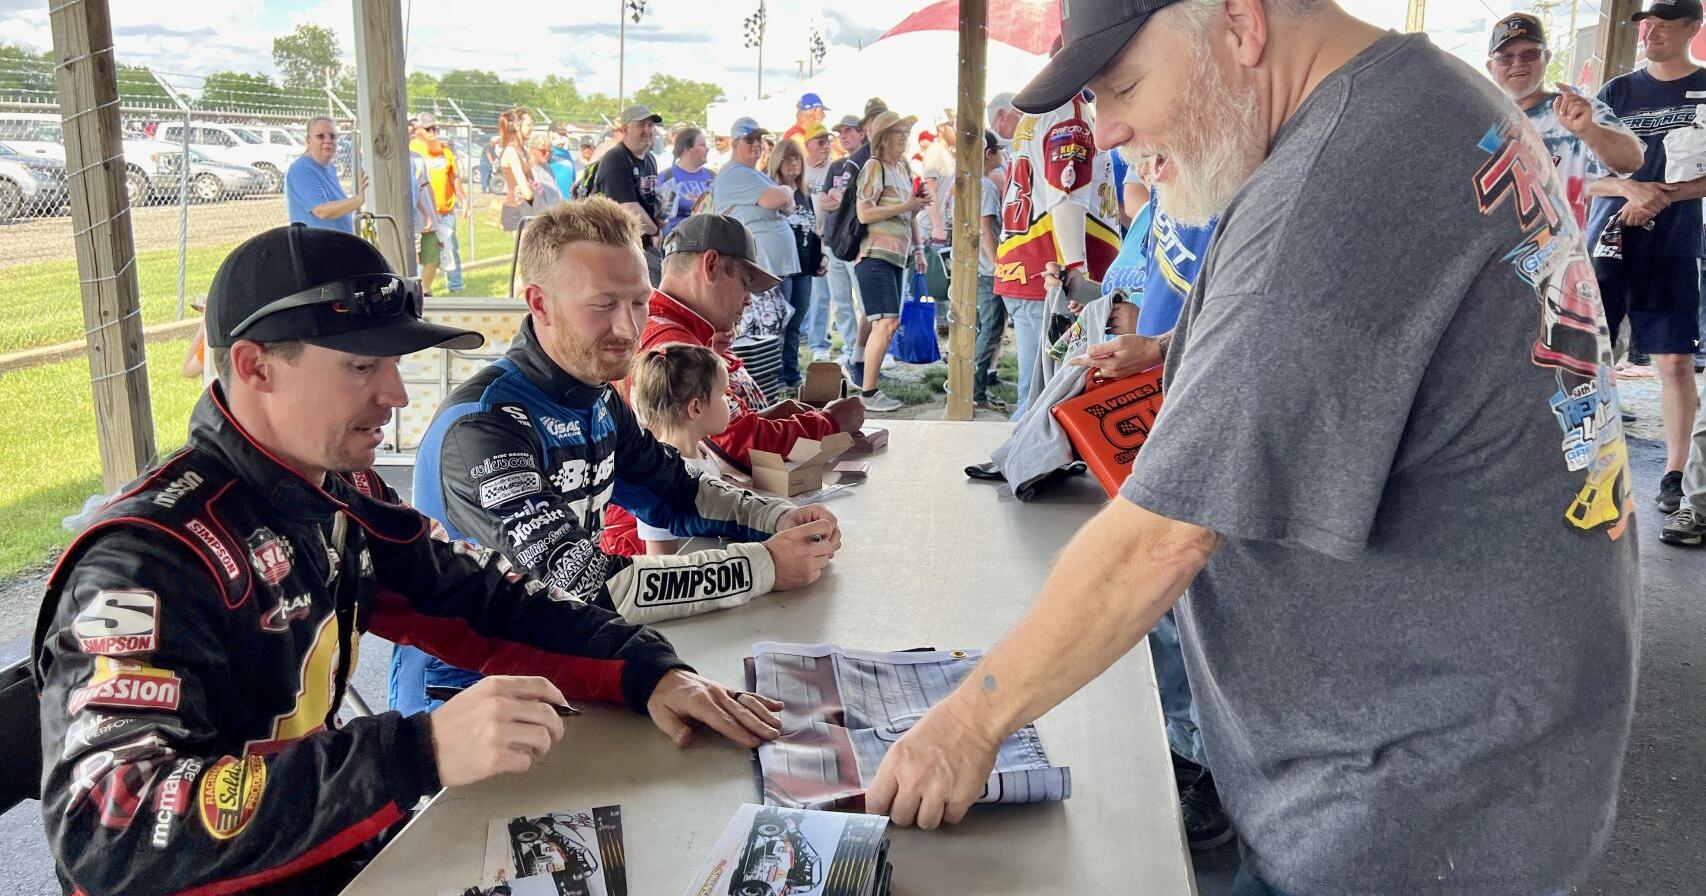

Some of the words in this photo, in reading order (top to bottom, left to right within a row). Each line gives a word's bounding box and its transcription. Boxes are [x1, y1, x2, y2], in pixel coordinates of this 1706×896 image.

[1106, 385, 1155, 410] VORES
[470, 454, 535, 478] wilwood
[189, 521, 237, 577] SIMPSON
[541, 538, 593, 588] SHARP
[83, 636, 151, 653] SIMPSON
